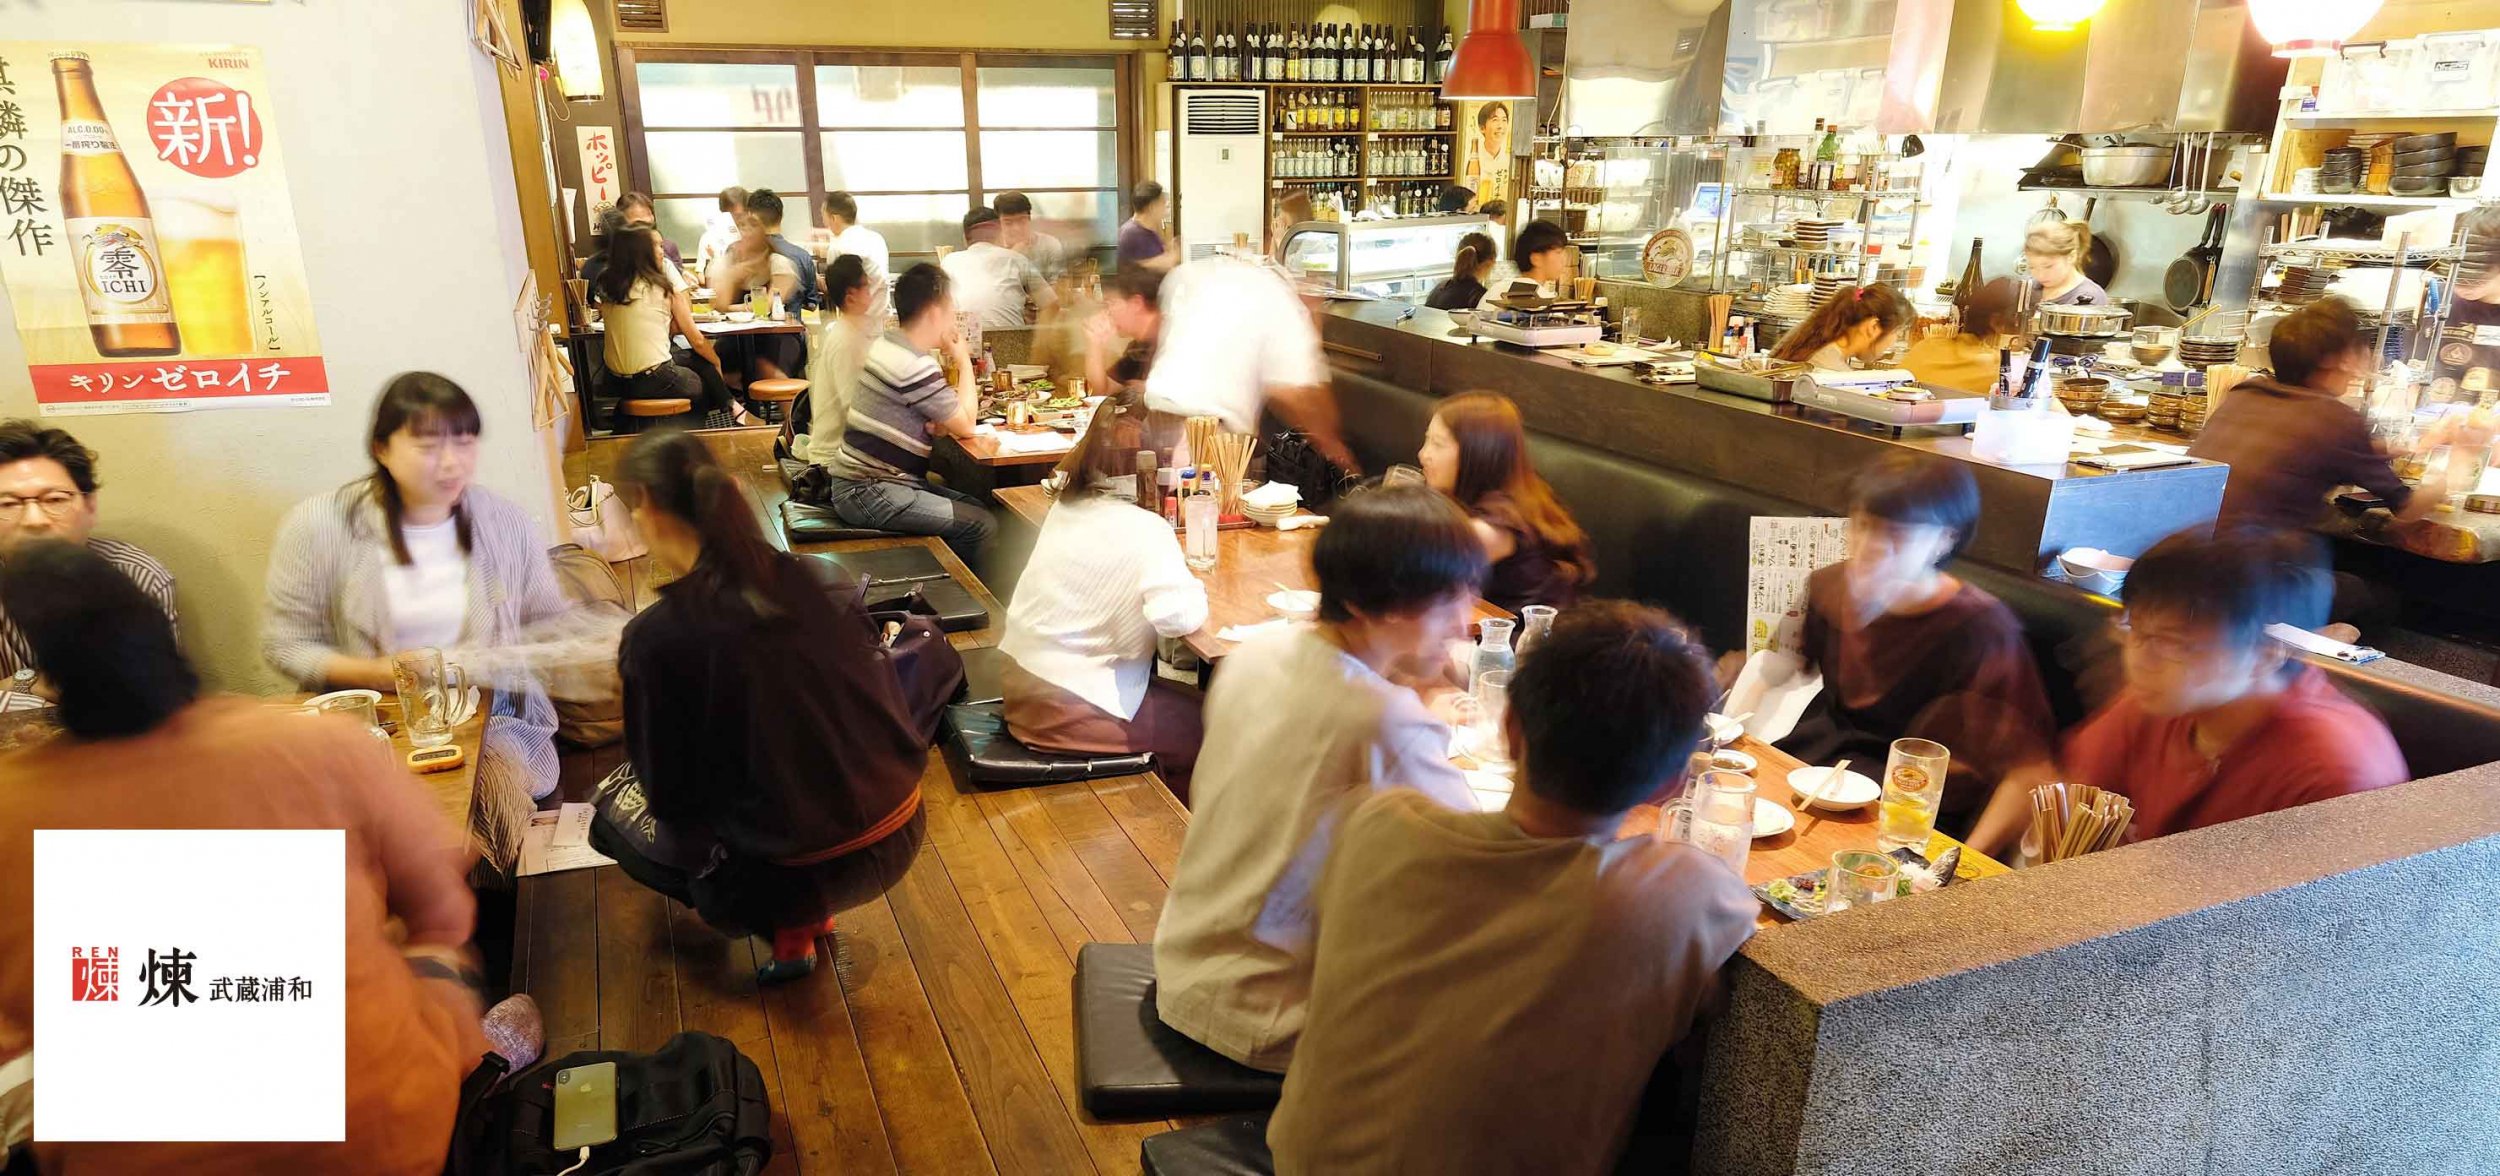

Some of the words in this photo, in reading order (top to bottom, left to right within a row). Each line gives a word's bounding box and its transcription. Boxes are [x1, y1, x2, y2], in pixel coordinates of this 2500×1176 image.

[208, 58, 249, 69] KIRIN
[153, 91, 258, 168] 新!
[0, 56, 54, 256] の傑作
[586, 131, 613, 201] ホッピー
[100, 249, 140, 279] 零
[101, 280, 147, 294] ICHI
